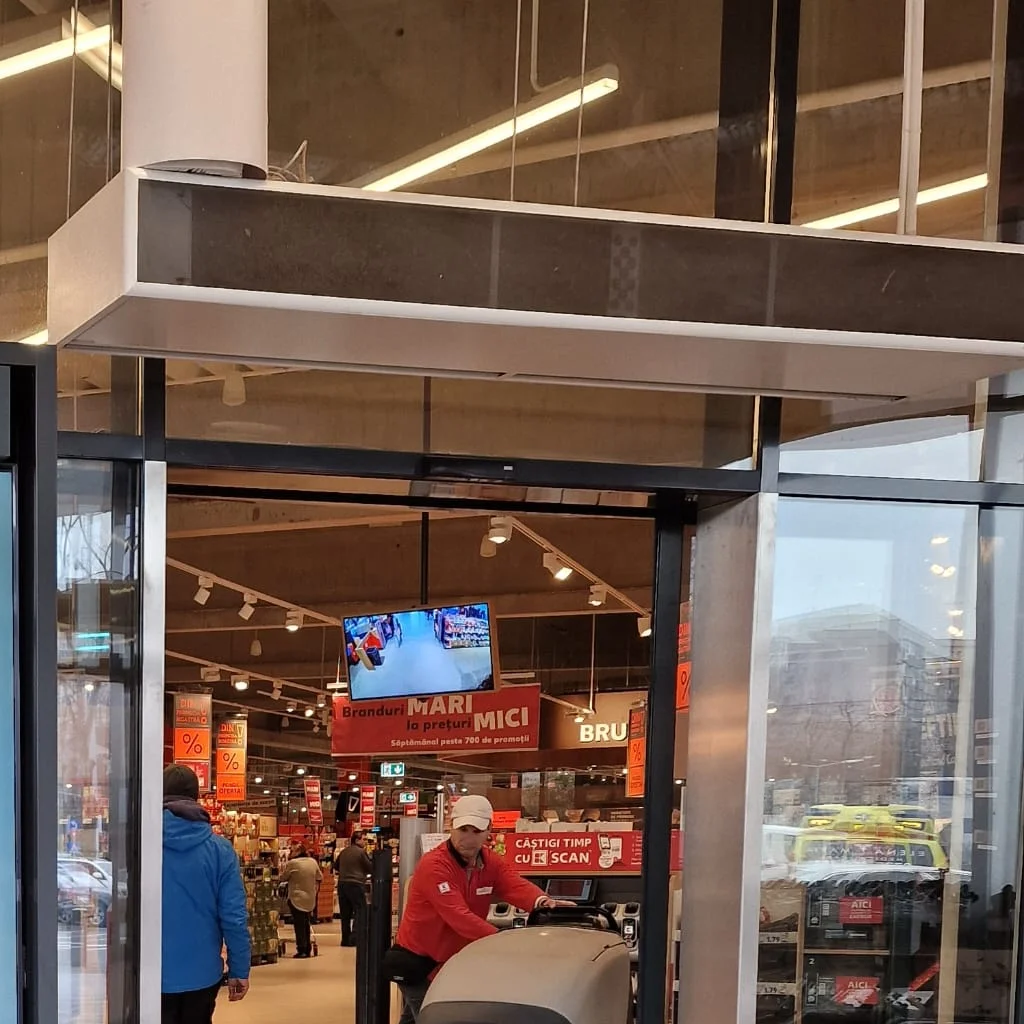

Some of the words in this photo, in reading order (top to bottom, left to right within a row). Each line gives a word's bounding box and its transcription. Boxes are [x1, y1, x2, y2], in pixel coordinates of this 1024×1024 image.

[342, 703, 404, 718] Branduri
[407, 694, 473, 716] MARI
[406, 719, 419, 731] la
[423, 717, 471, 733] prețuri
[474, 706, 528, 732] MICI
[441, 738, 462, 747] peste
[482, 736, 491, 744] de
[494, 735, 530, 746] promoții
[563, 838, 592, 848] TIMP
[515, 854, 530, 863] CU
[551, 852, 590, 863] SCAN
[851, 901, 872, 909] AICI
[847, 981, 868, 989] AICI
